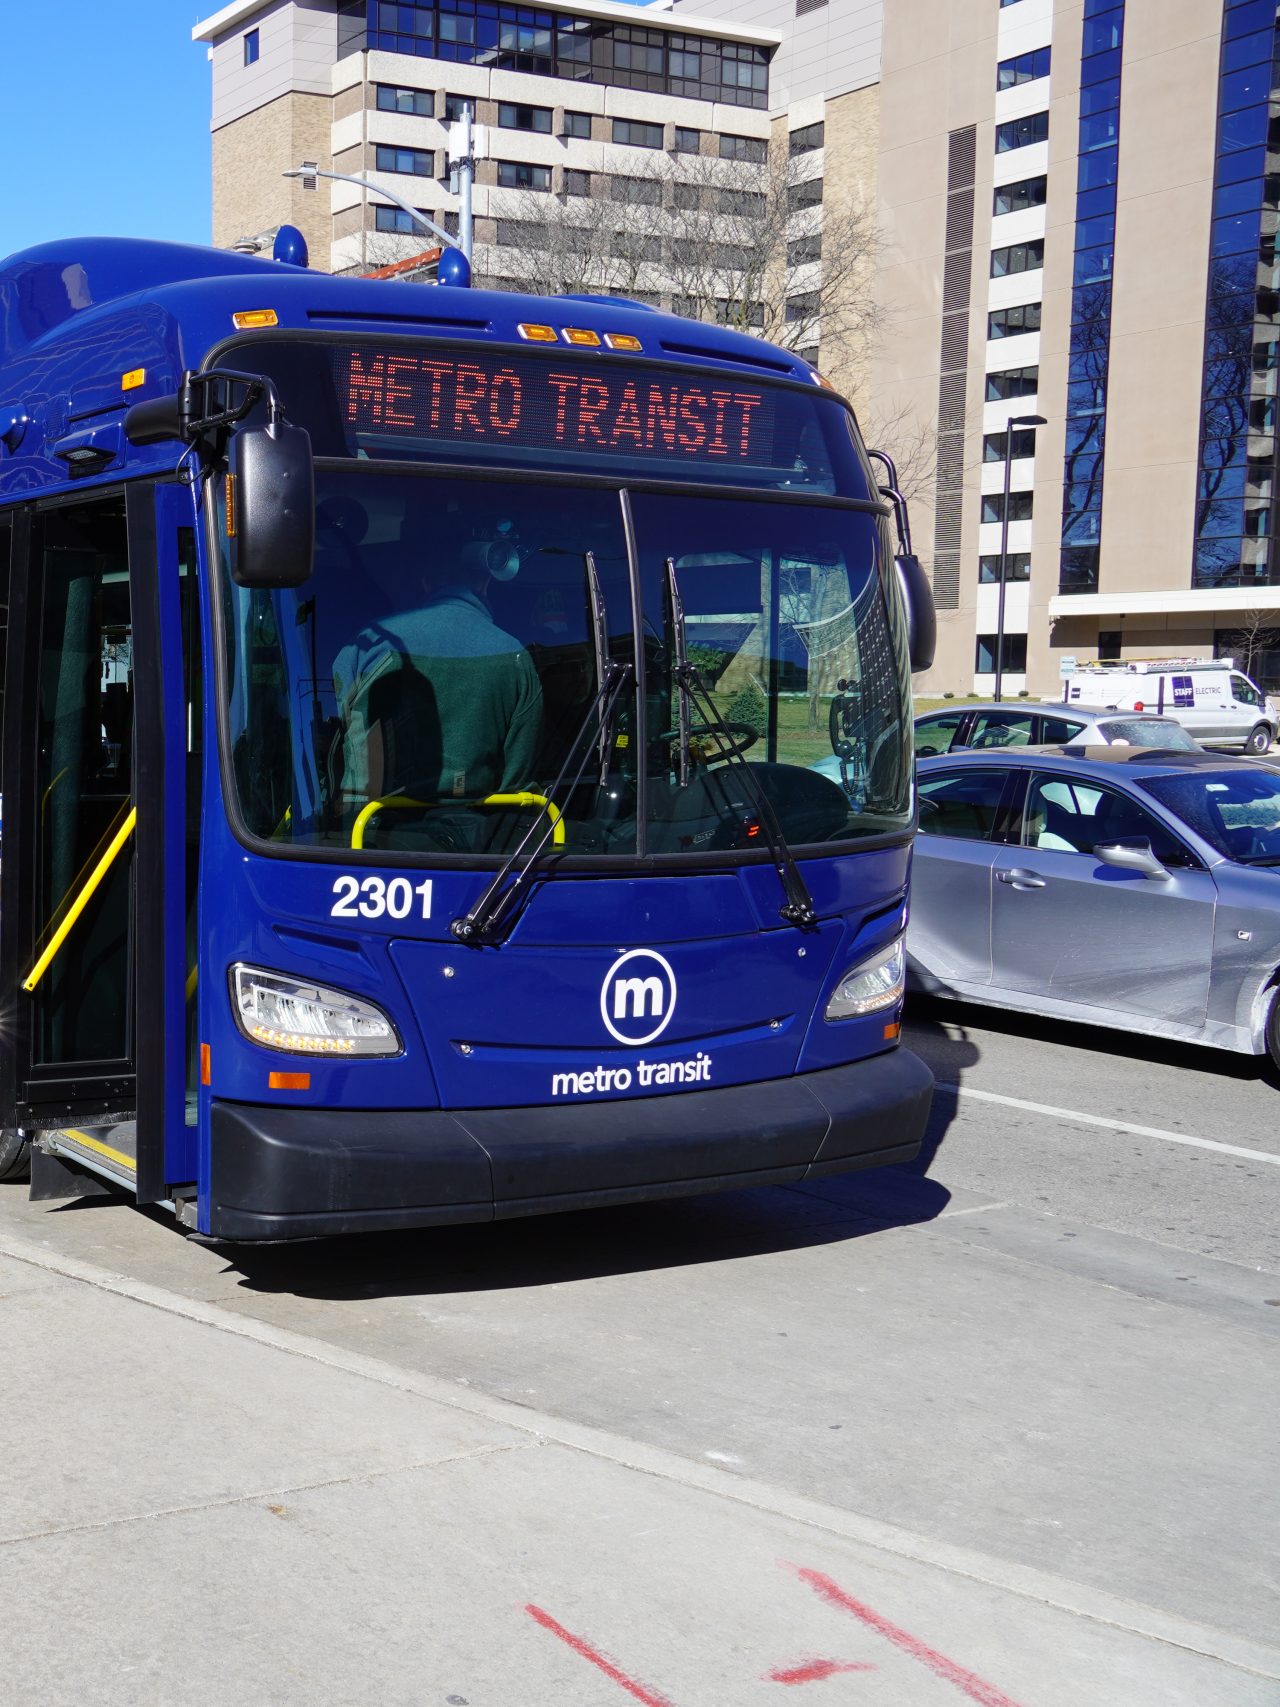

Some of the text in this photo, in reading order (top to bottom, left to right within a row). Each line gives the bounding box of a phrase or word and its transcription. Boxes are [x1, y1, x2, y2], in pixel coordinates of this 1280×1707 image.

[348, 352, 762, 457] METRO TRANSIT
[1174, 686, 1222, 697] STAFF ELECTRIC
[330, 876, 433, 919] 2301
[551, 1052, 712, 1096] metro transit
